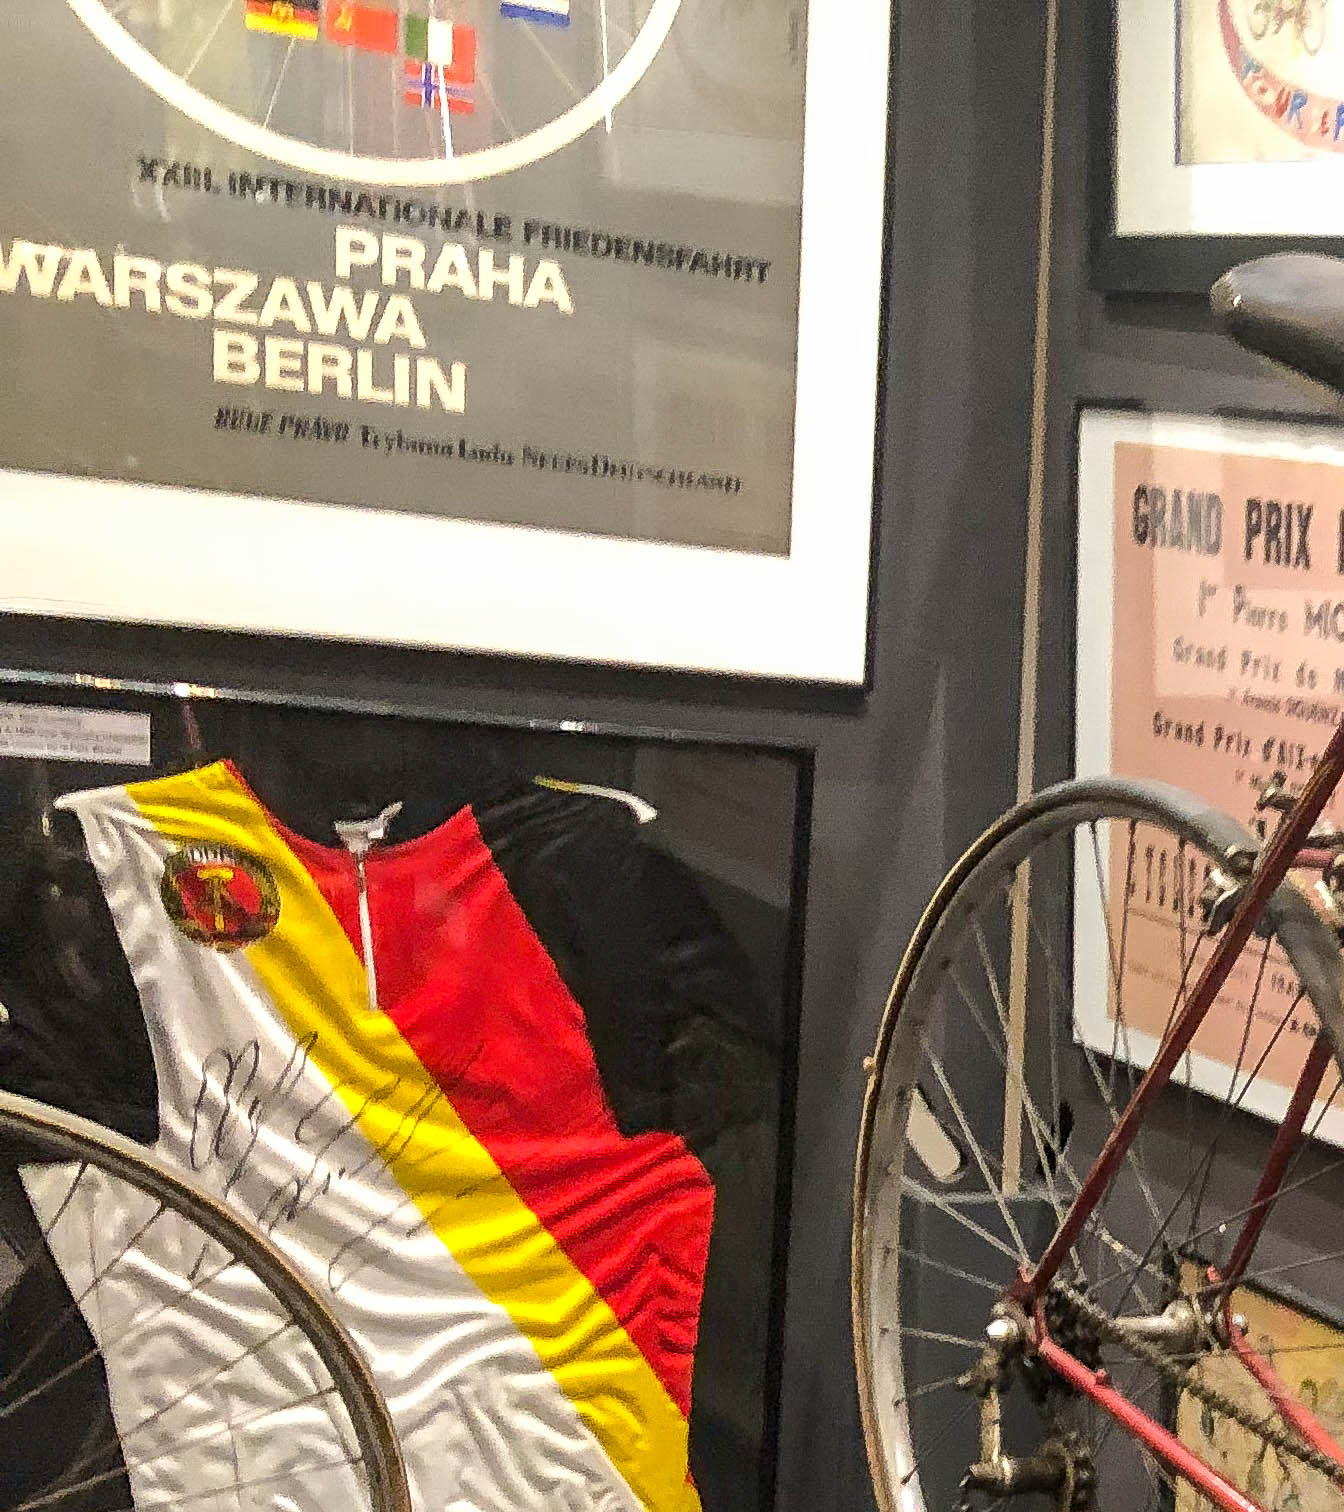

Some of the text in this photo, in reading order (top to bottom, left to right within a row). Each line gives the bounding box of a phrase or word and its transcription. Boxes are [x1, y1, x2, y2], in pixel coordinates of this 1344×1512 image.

[228, 170, 512, 243] INTERNATIONALE
[523, 214, 774, 286] FRIEDENSFAHRT
[334, 223, 576, 317] PRAHA
[0, 238, 428, 349] WARSZAWA
[212, 328, 467, 414] BERLIN
[1132, 483, 1224, 557] GRAND
[1244, 496, 1313, 571] PRIX
[1172, 634, 1227, 673] Grand
[1241, 649, 1281, 683] Prix
[1151, 710, 1205, 748] Grand
[1213, 723, 1251, 758] Prix
